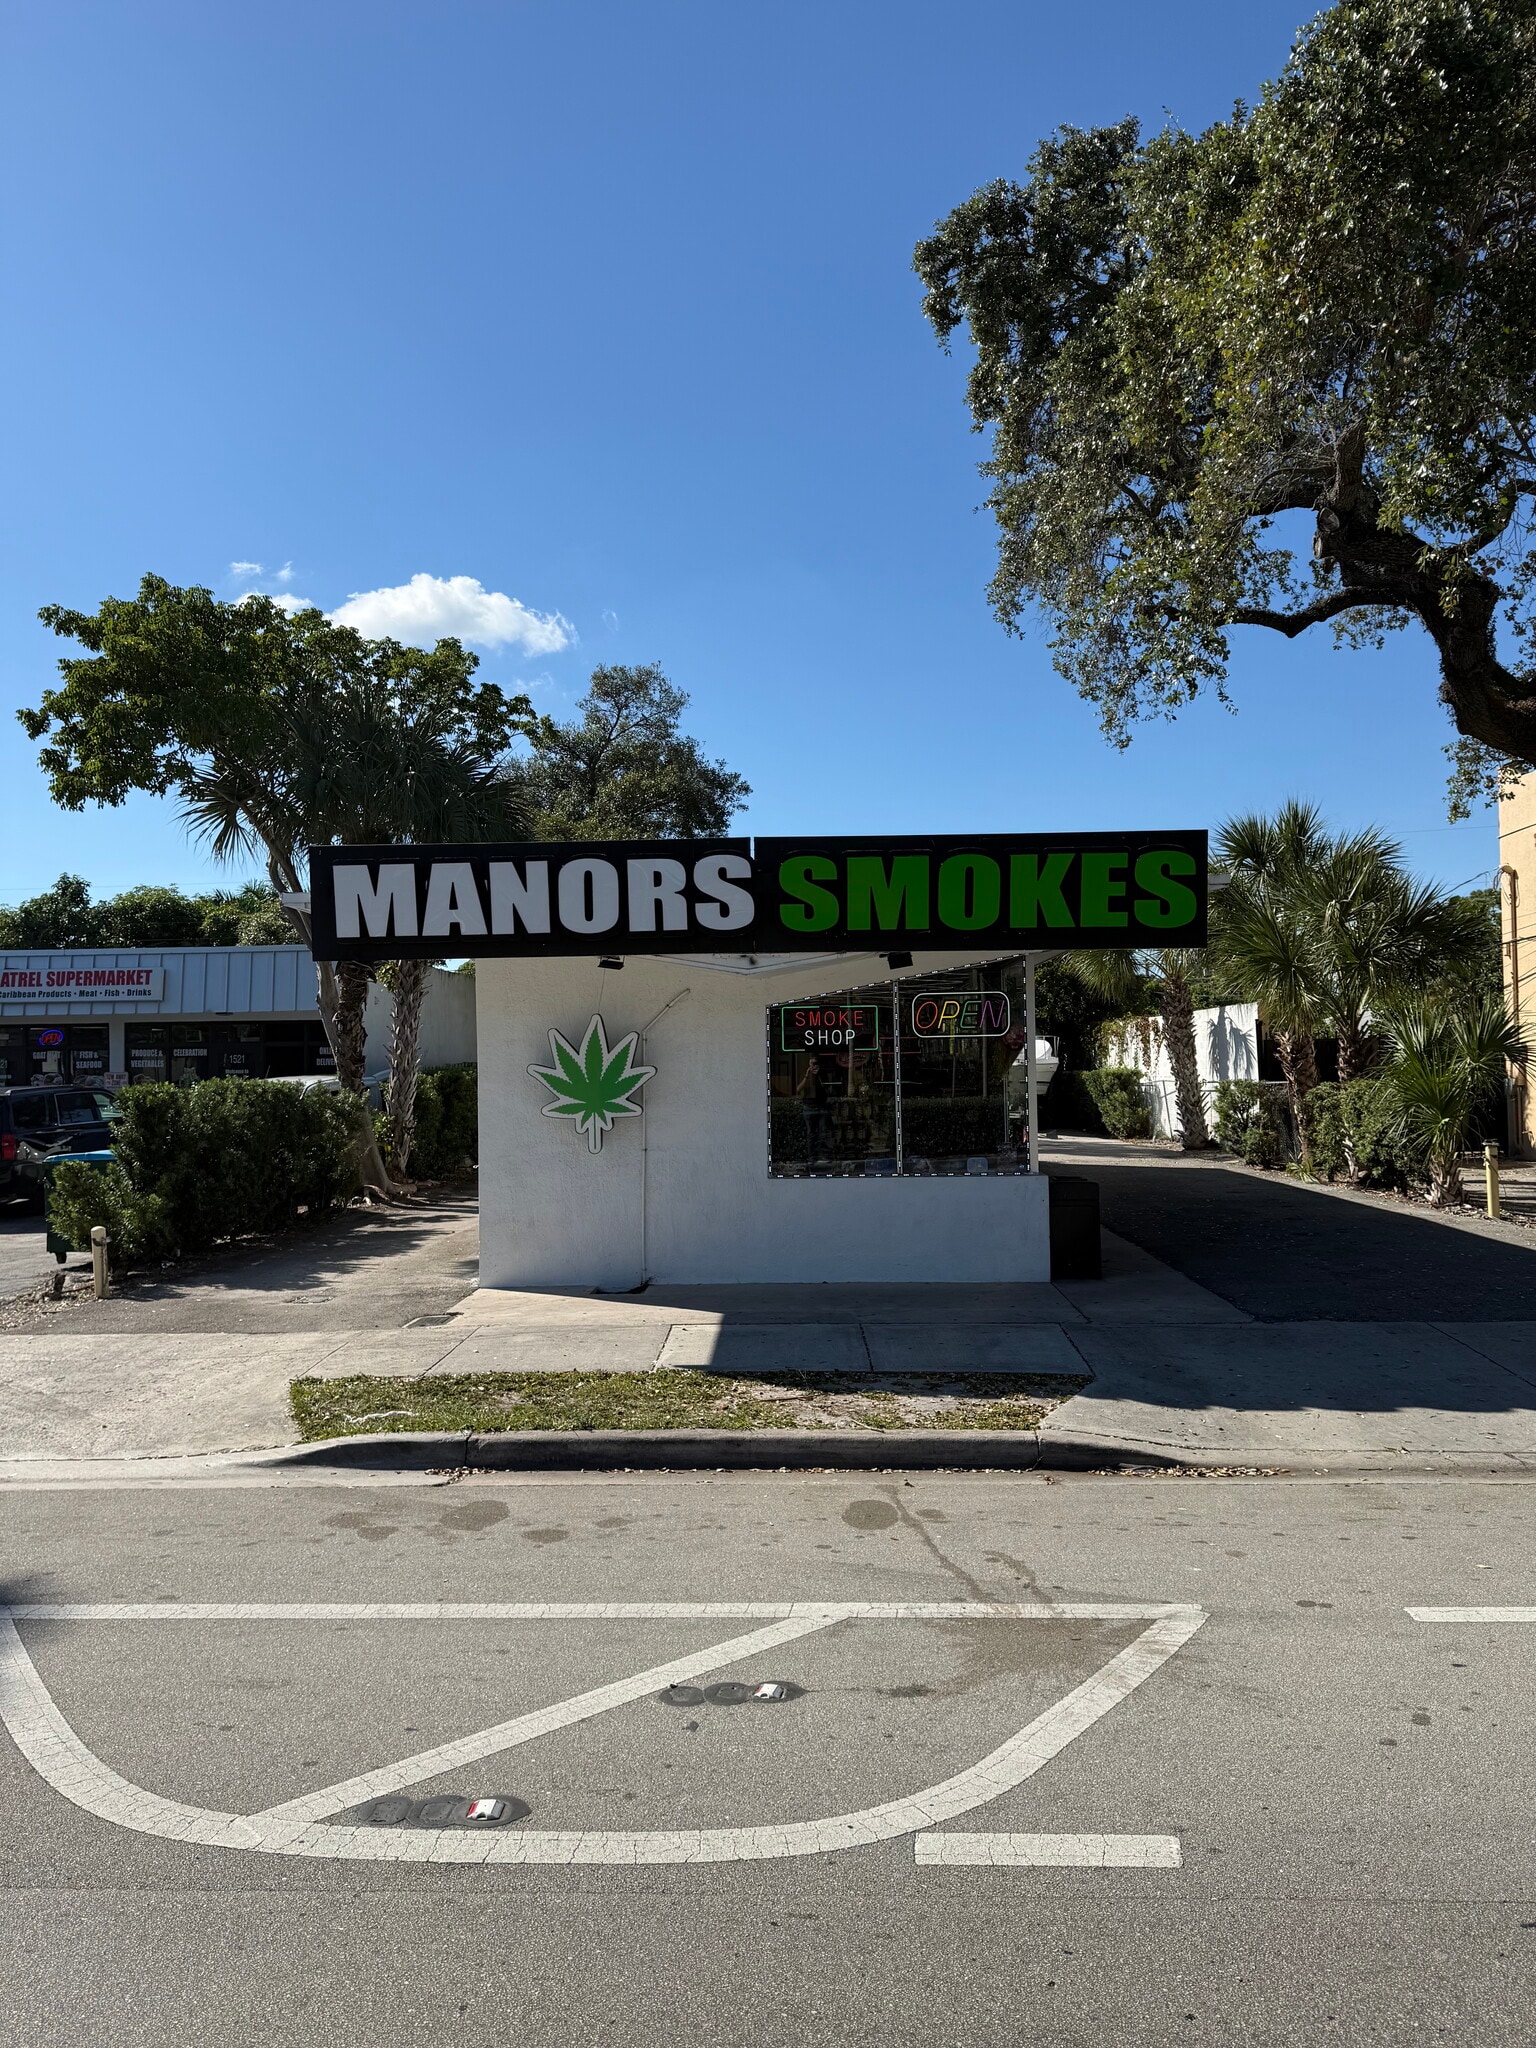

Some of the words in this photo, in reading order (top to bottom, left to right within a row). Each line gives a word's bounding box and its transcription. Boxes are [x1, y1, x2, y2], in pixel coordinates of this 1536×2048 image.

[333, 854, 755, 937] MANORS
[778, 851, 1197, 931] SMOKES
[0, 971, 42, 987] ATREL
[46, 970, 153, 987] SUPERMARKET
[38, 989, 72, 998] Products
[79, 989, 98, 998] Meat
[104, 989, 120, 997] Fish
[127, 988, 152, 997] Drinks
[795, 1010, 864, 1027] SMOKE
[916, 1000, 1005, 1029] OPEN
[41, 1033, 60, 1044] OPEN
[804, 1029, 856, 1046] SHOP
[79, 1050, 93, 1059] FISH
[131, 1048, 156, 1057] PRODUCE
[173, 1048, 208, 1057] CELEBRATION
[130, 1059, 164, 1068] VEGETABLES
[229, 1054, 245, 1064] 1521
[75, 1060, 103, 1069] SEAFOOD
